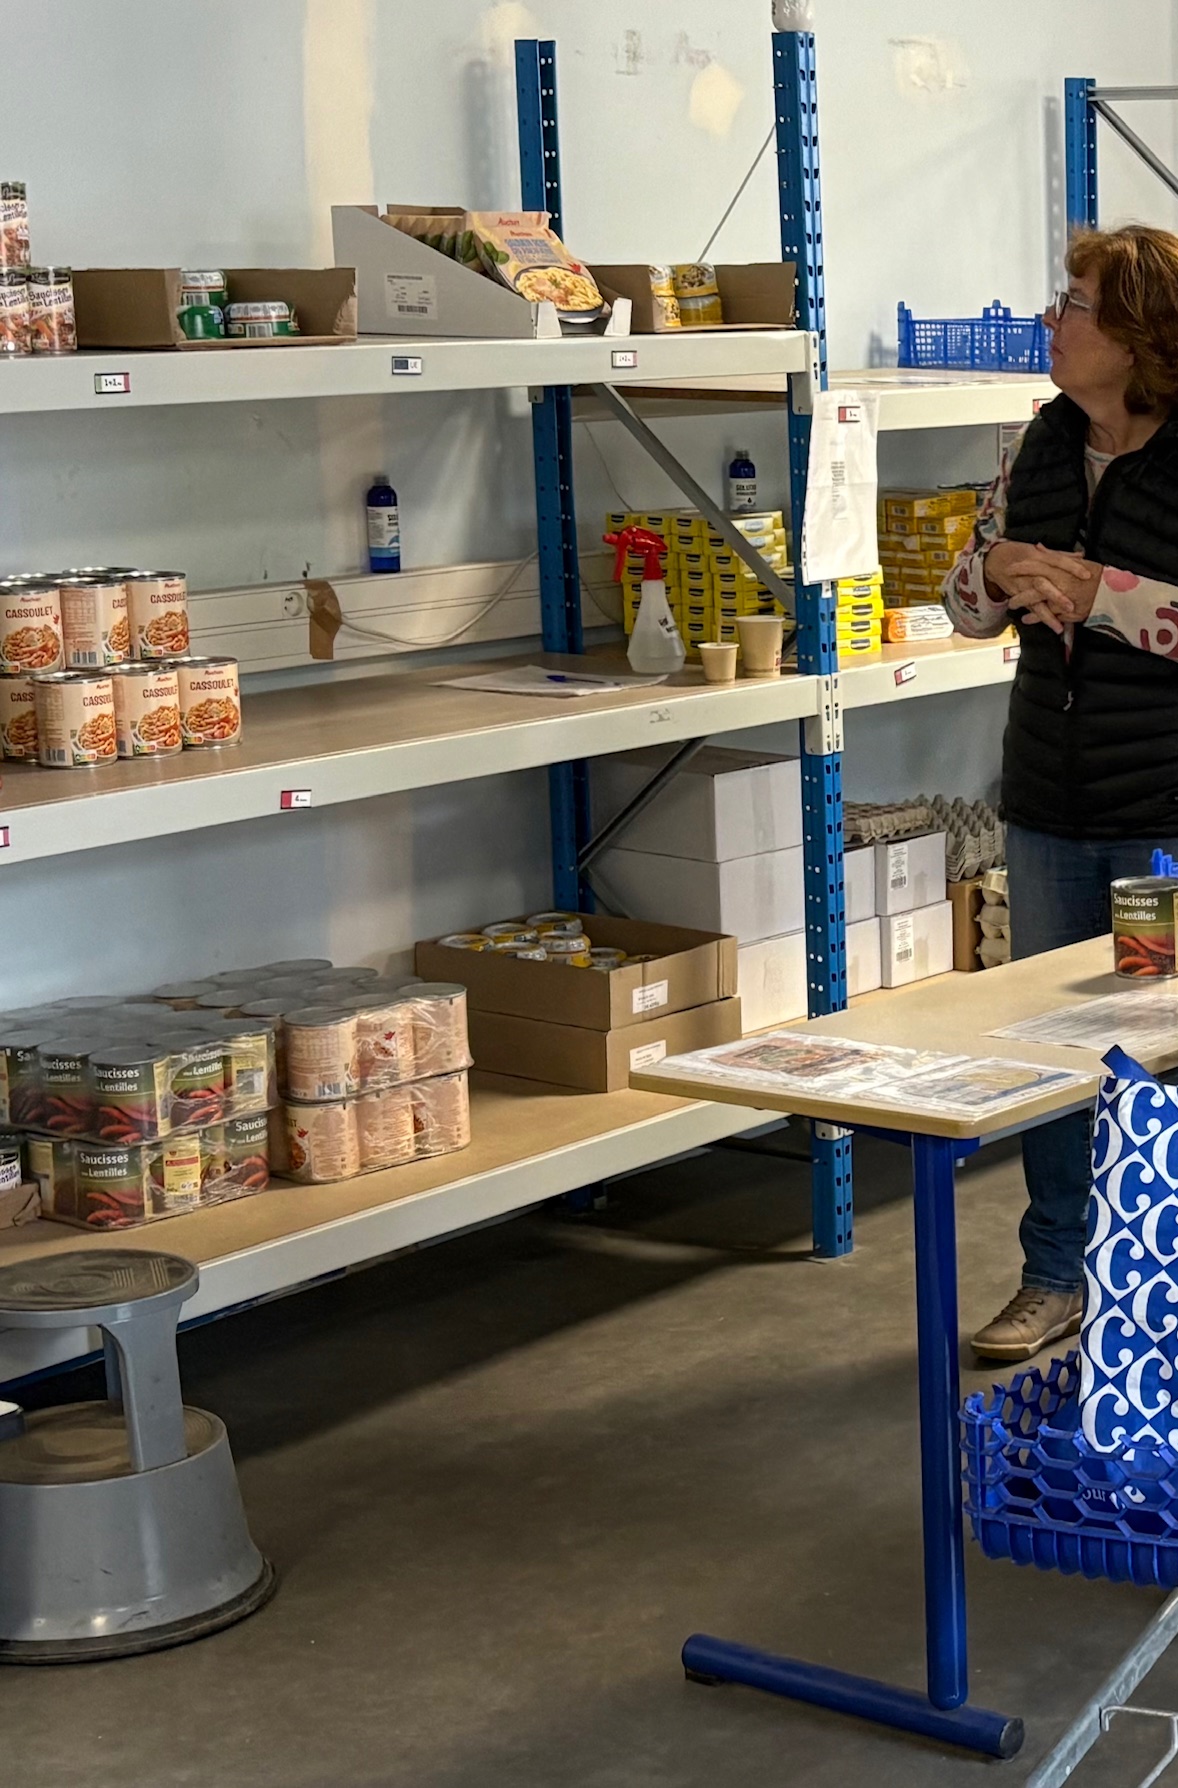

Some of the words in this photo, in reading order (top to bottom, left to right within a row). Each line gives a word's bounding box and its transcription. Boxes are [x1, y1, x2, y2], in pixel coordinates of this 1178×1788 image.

[150, 592, 186, 604] CASSOULE
[5, 605, 53, 619] CASSOULET
[189, 678, 234, 691] CASSOULET
[10, 692, 36, 703] CASS
[1113, 893, 1160, 907] Saucisses
[1119, 909, 1157, 921] Lentilles
[100, 1081, 138, 1092] Lentilles
[80, 1152, 129, 1165] Saucisses
[89, 1167, 128, 1178] Lentilles
